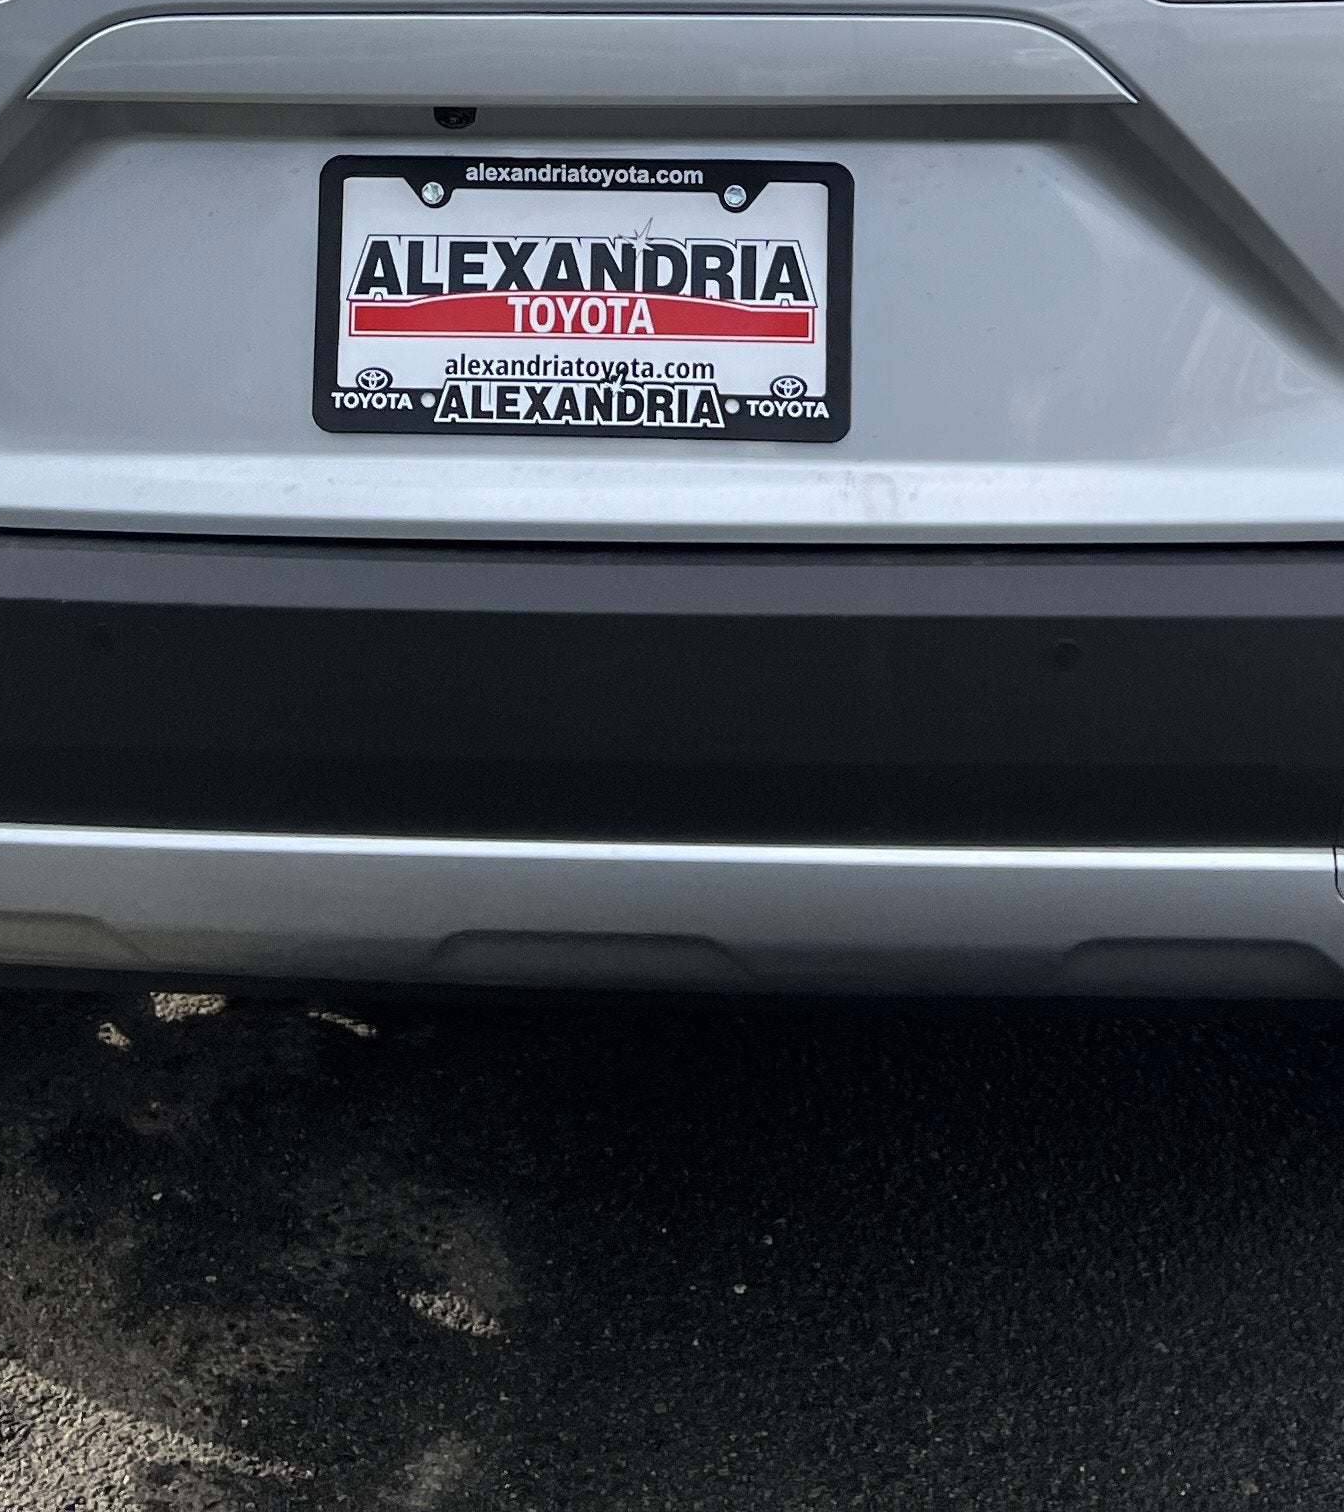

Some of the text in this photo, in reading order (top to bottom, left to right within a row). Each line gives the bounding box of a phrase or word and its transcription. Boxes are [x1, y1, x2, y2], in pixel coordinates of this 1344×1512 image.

[465, 163, 704, 187] alexandriatoyota.com
[353, 239, 811, 302] ALEXANDRIA
[508, 297, 655, 336] TOYOTA
[445, 355, 715, 380] alexandriatoyota.com
[332, 381, 830, 428] TOYOTA ALEXANDRIA TOYOTA
